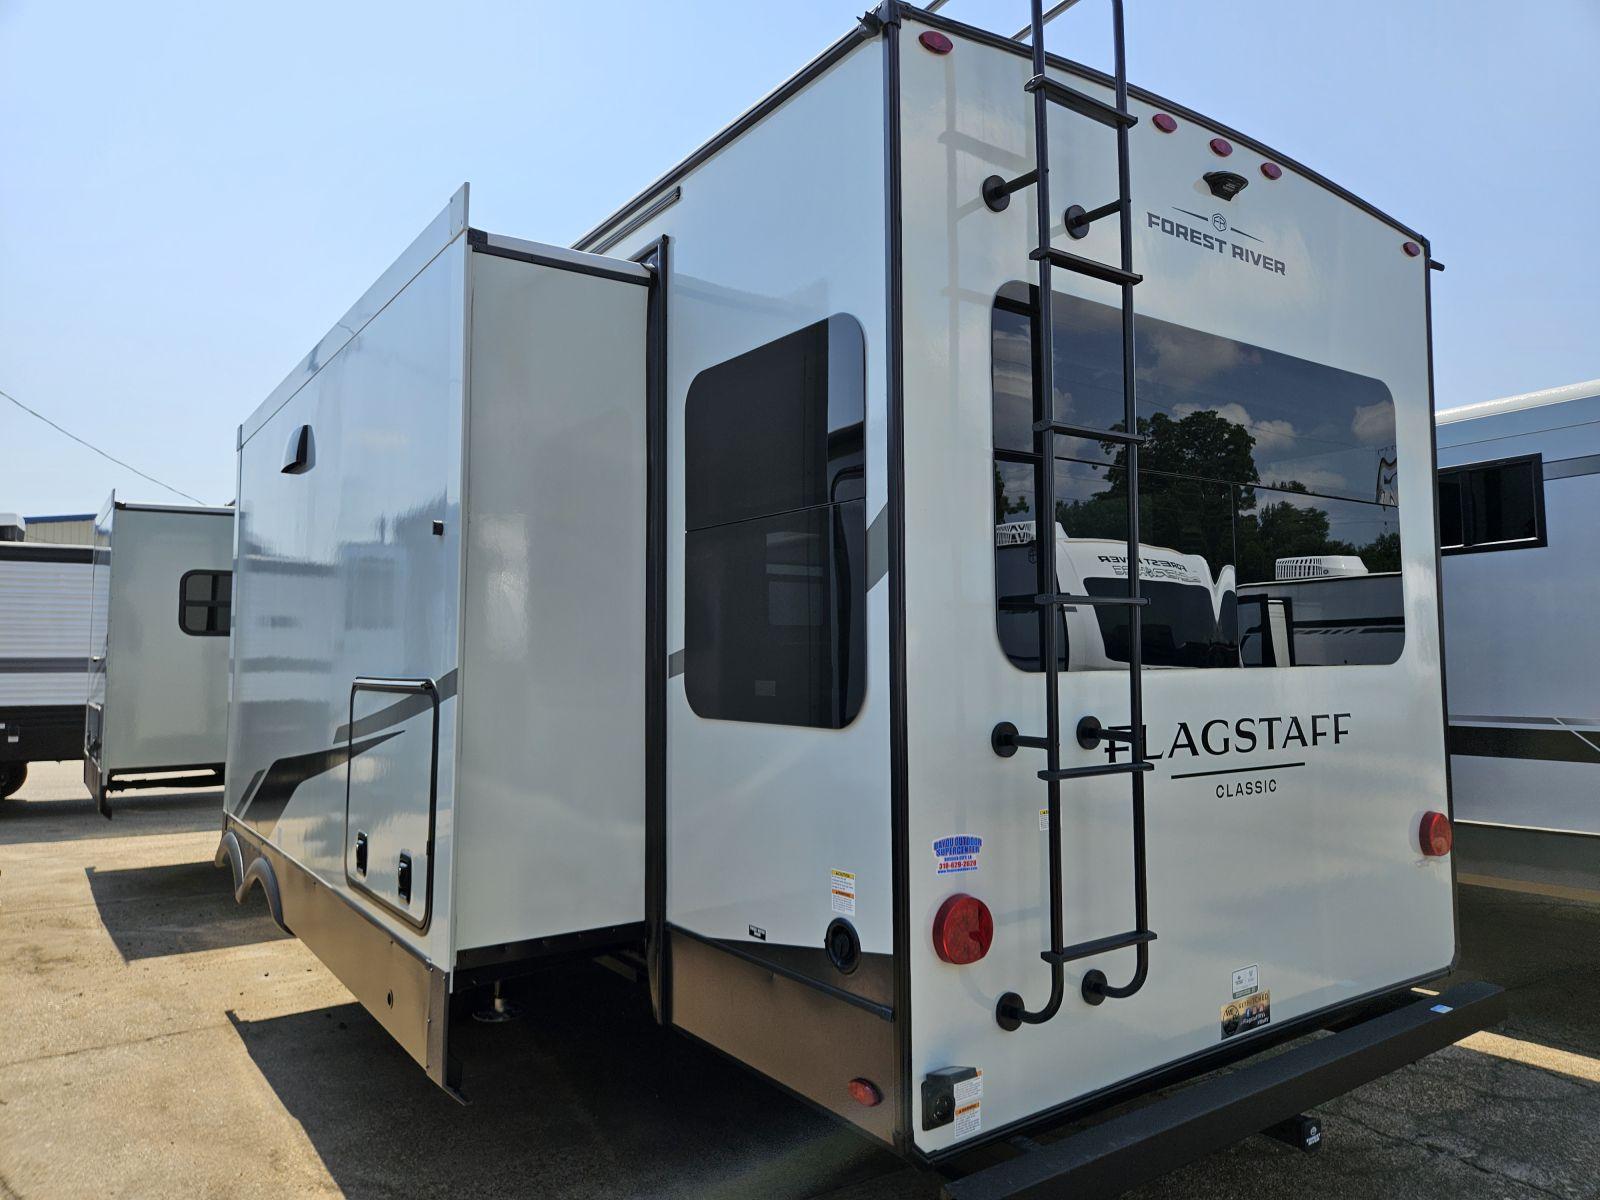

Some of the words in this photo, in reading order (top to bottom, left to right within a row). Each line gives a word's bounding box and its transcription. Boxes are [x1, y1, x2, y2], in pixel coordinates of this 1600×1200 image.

[1147, 212, 1227, 254] FOREST
[1231, 243, 1286, 276] RIVER
[1104, 713, 1351, 764] FLAGSTAFF
[1216, 779, 1278, 799] CLASSIC
